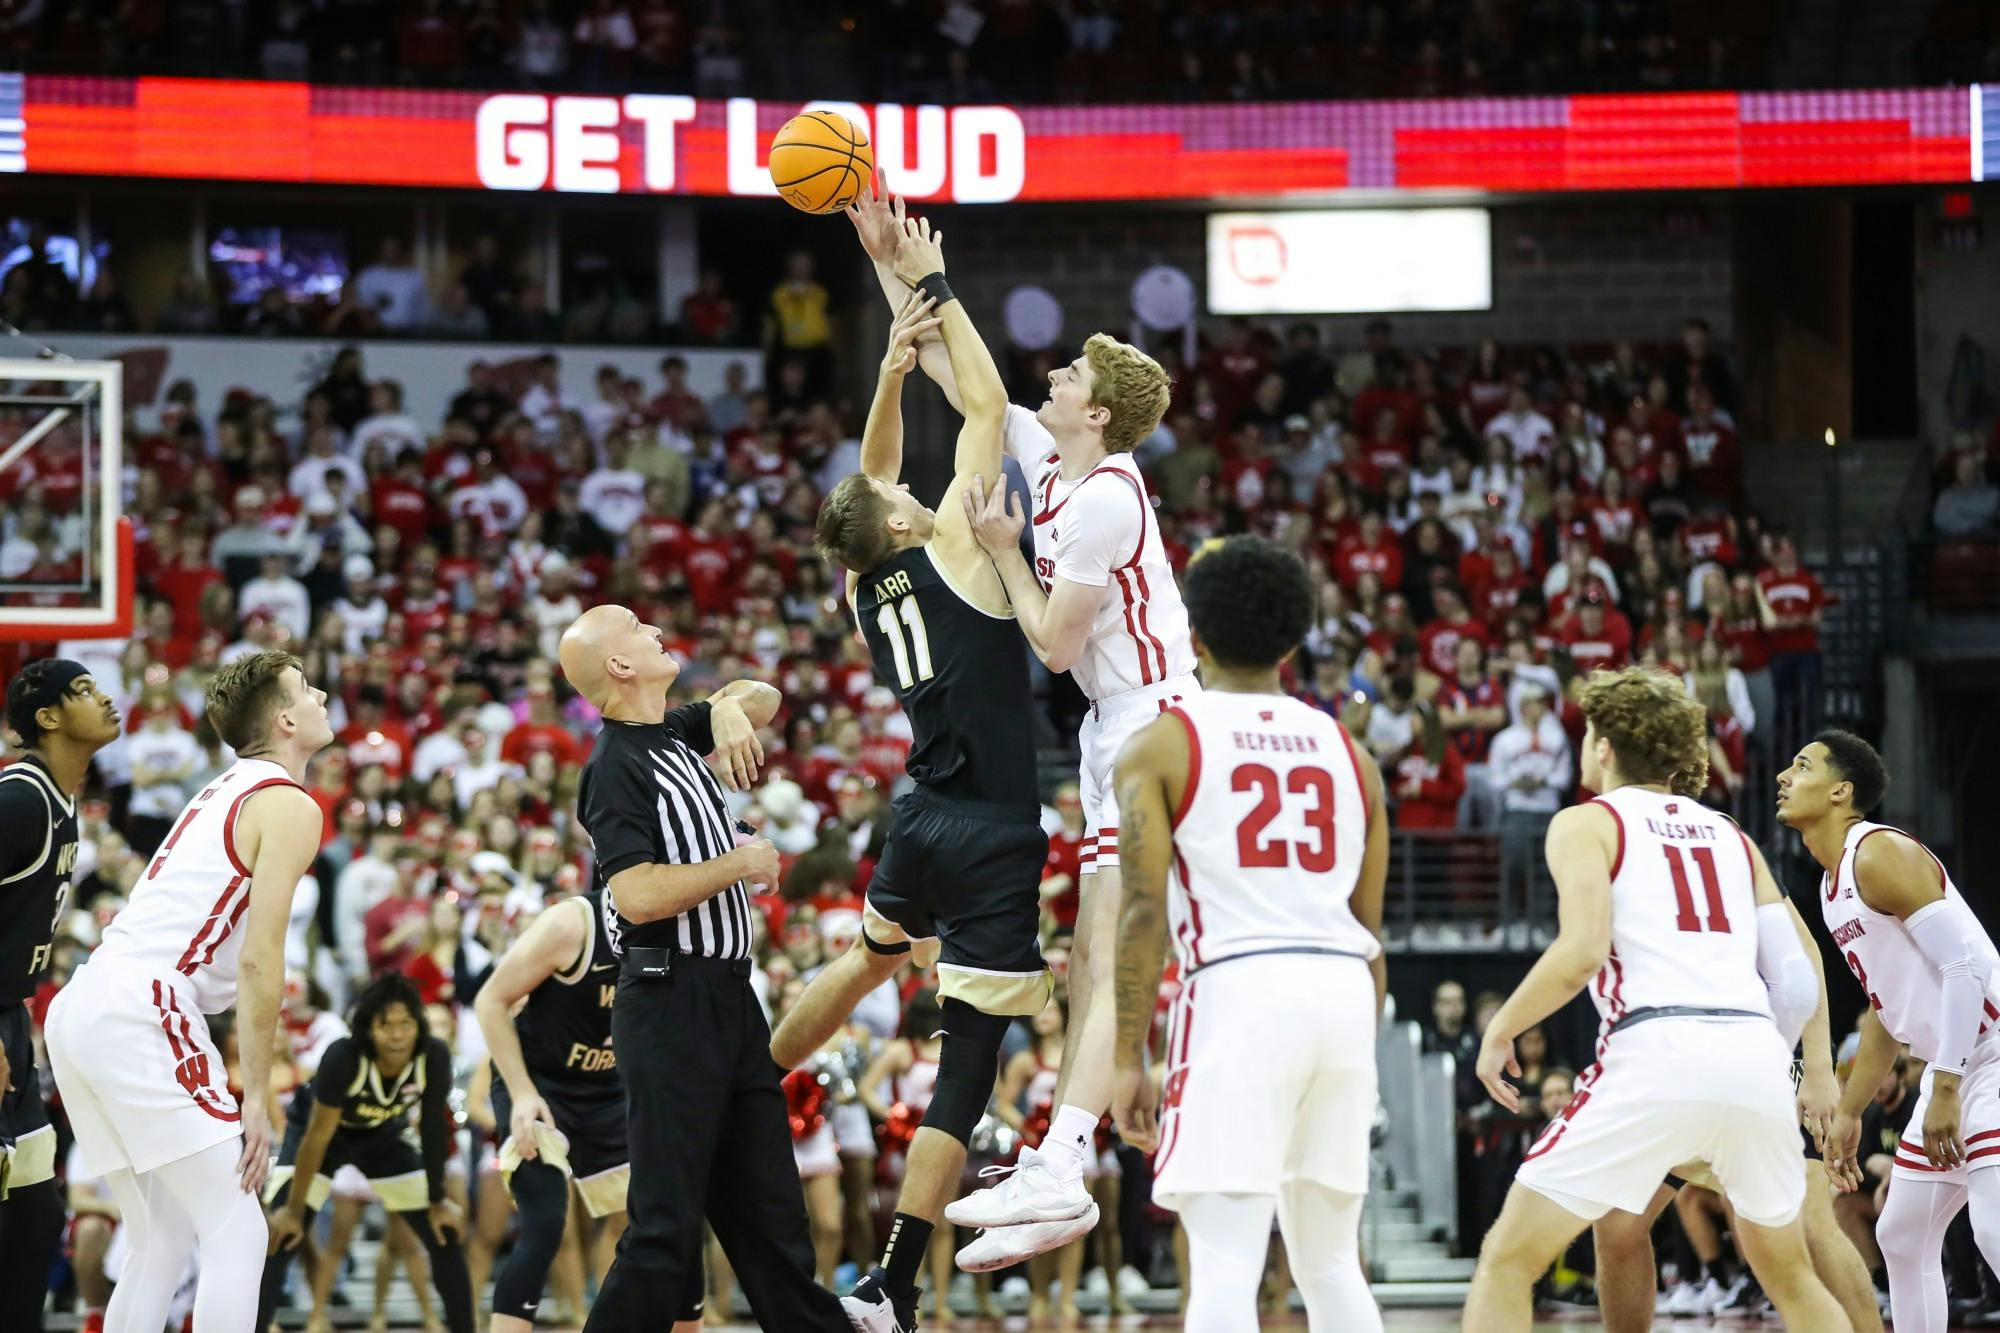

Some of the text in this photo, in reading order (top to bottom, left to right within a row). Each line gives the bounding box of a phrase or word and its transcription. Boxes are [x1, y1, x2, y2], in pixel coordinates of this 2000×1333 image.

[476, 94, 1025, 203] GET LUD
[877, 594, 934, 690] 11
[1232, 731, 1319, 752] HEPBURN
[1231, 763, 1336, 873] 23
[1662, 844, 1732, 934] 11
